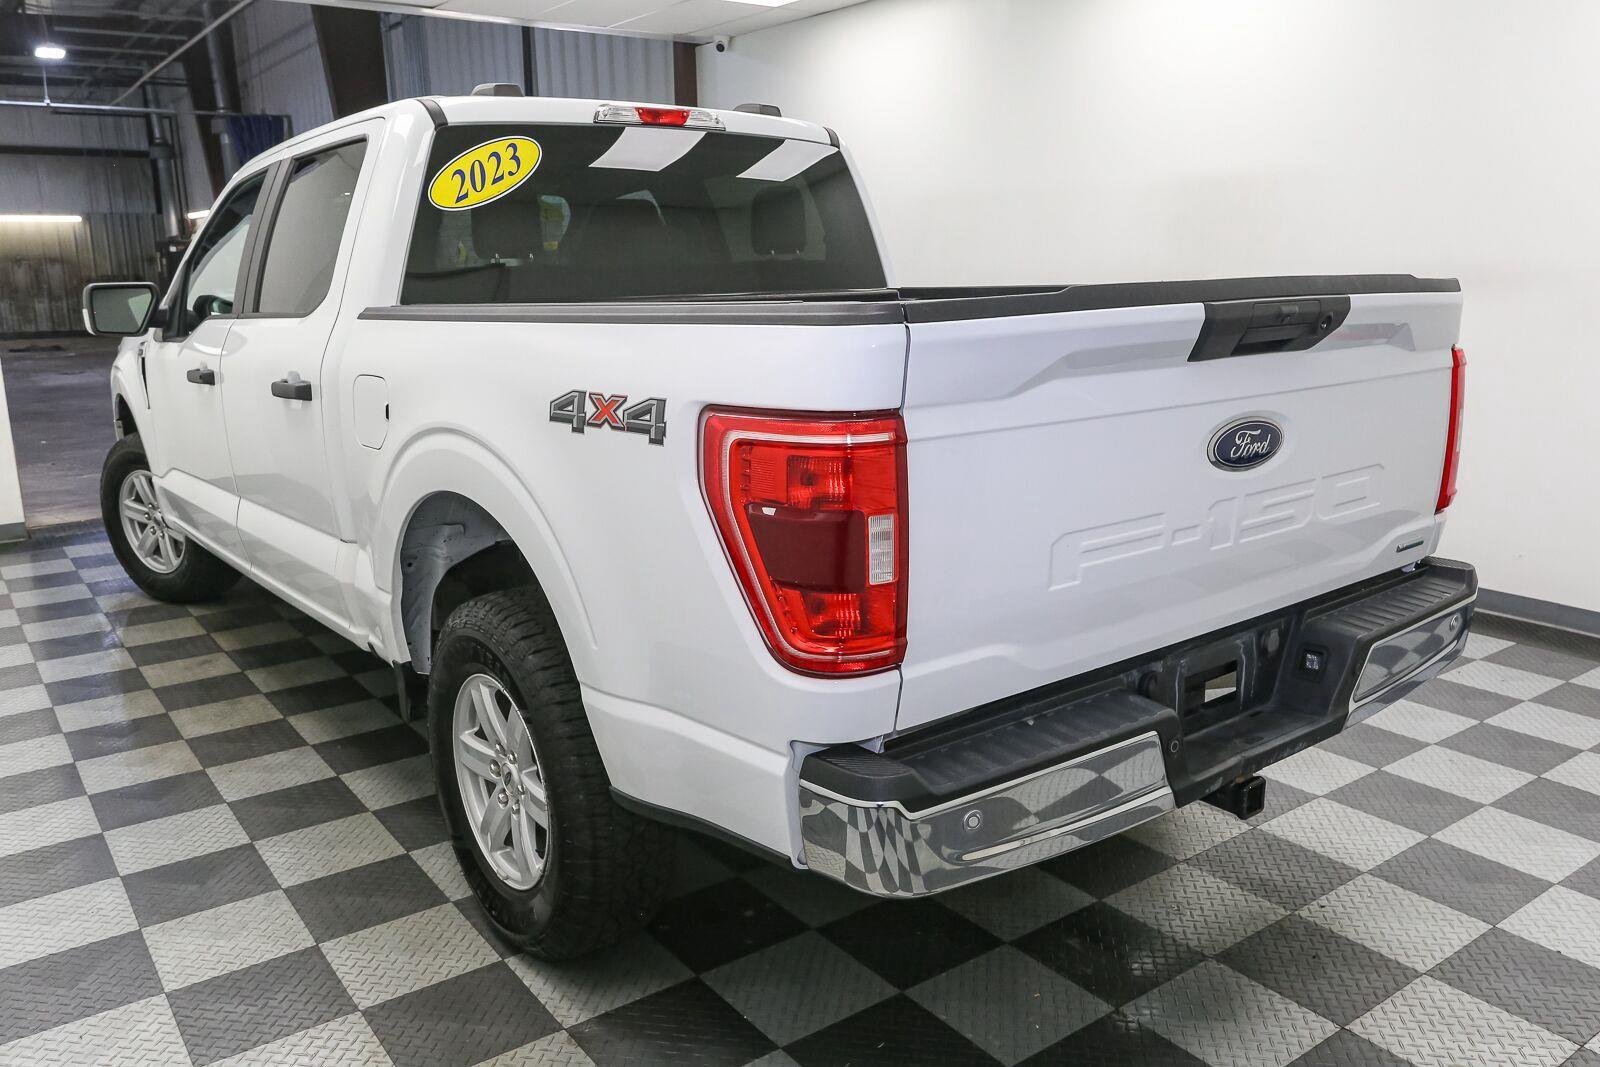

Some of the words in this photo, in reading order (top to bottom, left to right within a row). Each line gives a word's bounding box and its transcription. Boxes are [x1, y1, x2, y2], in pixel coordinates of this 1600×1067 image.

[451, 142, 521, 204] 2023
[1230, 429, 1271, 458] Ford
[1048, 463, 1385, 591] F-150
